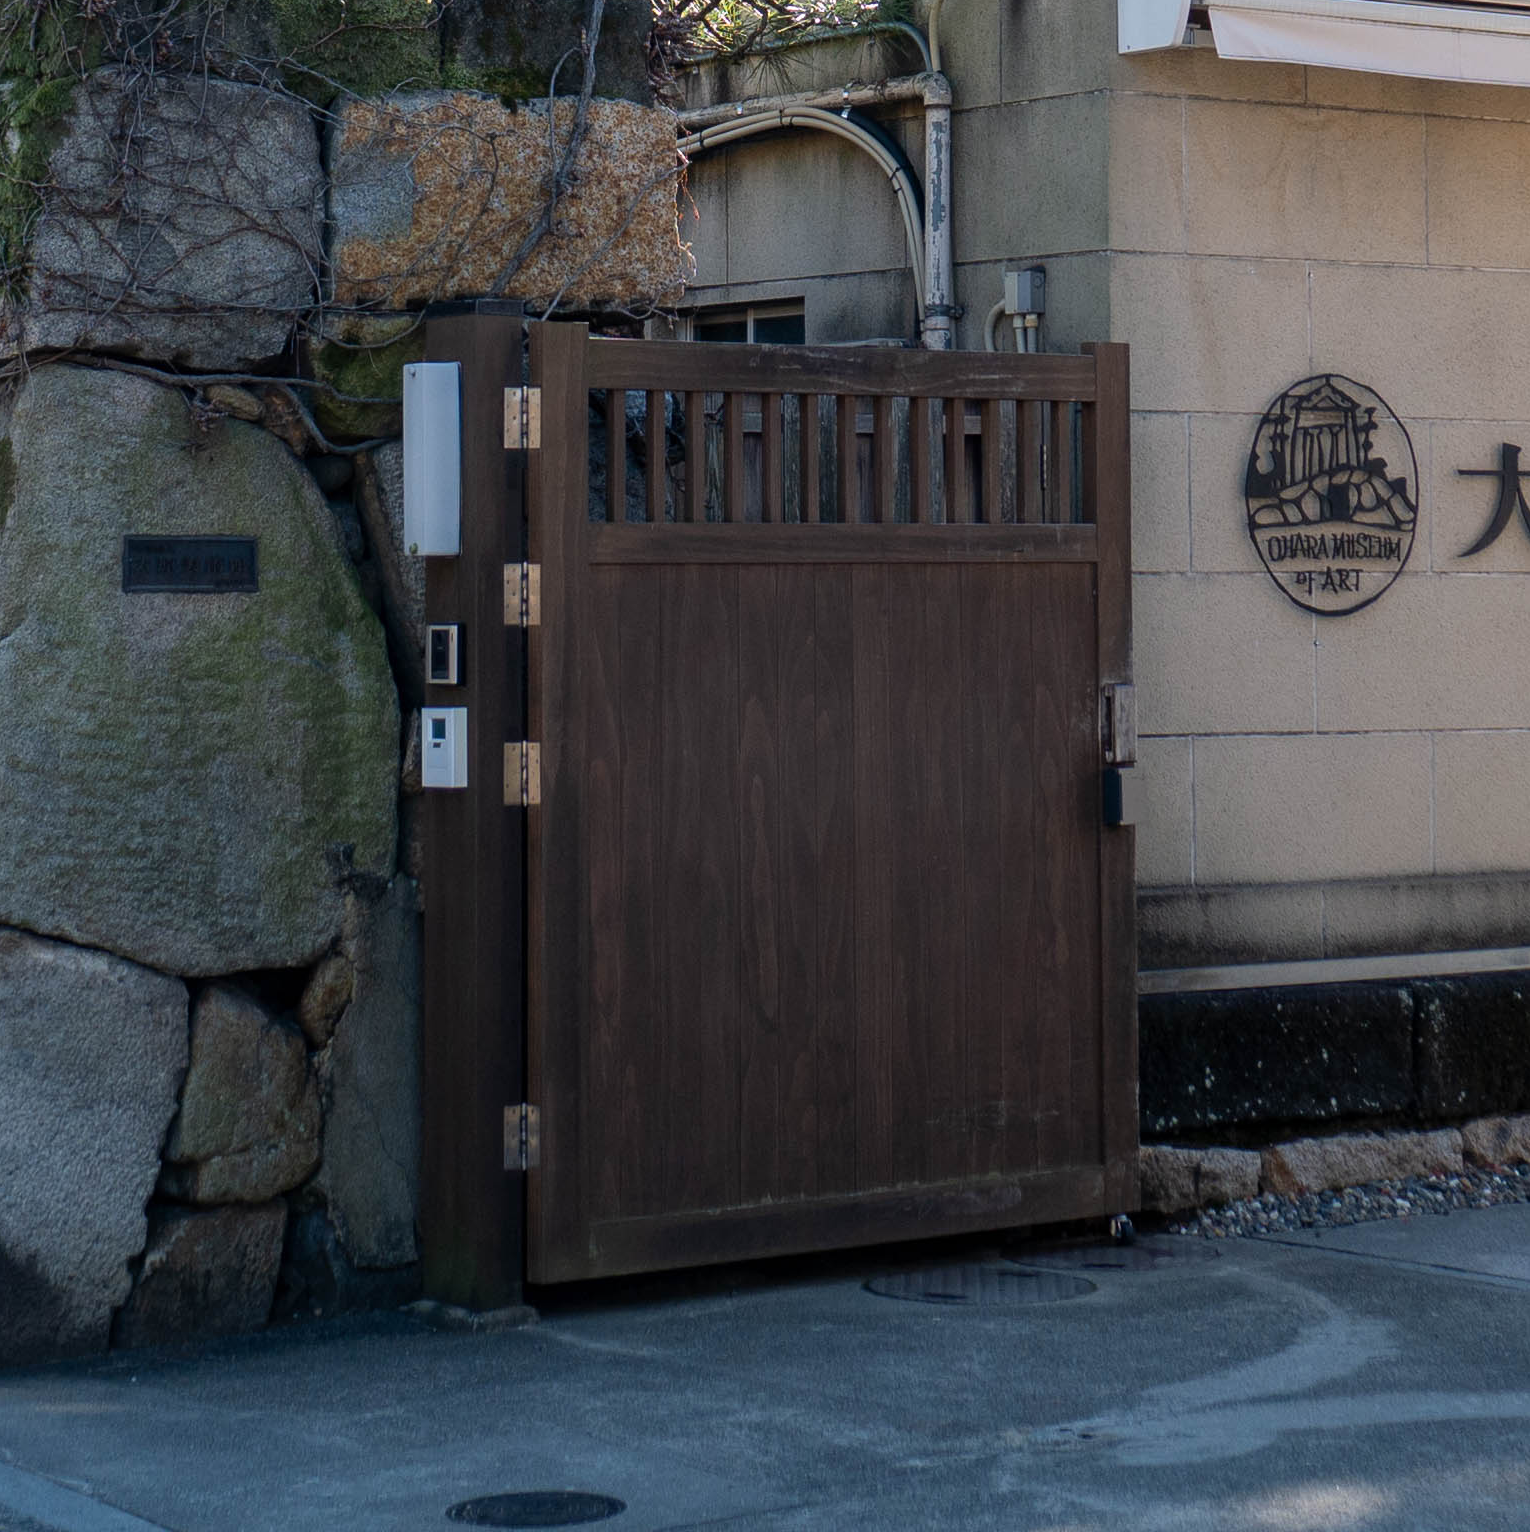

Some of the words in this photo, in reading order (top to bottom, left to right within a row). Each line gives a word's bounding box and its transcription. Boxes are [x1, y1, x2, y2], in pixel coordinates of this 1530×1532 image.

[1267, 532, 1329, 562] OHARA
[1331, 532, 1402, 562] MUSEUM
[1321, 566, 1364, 595] ART
